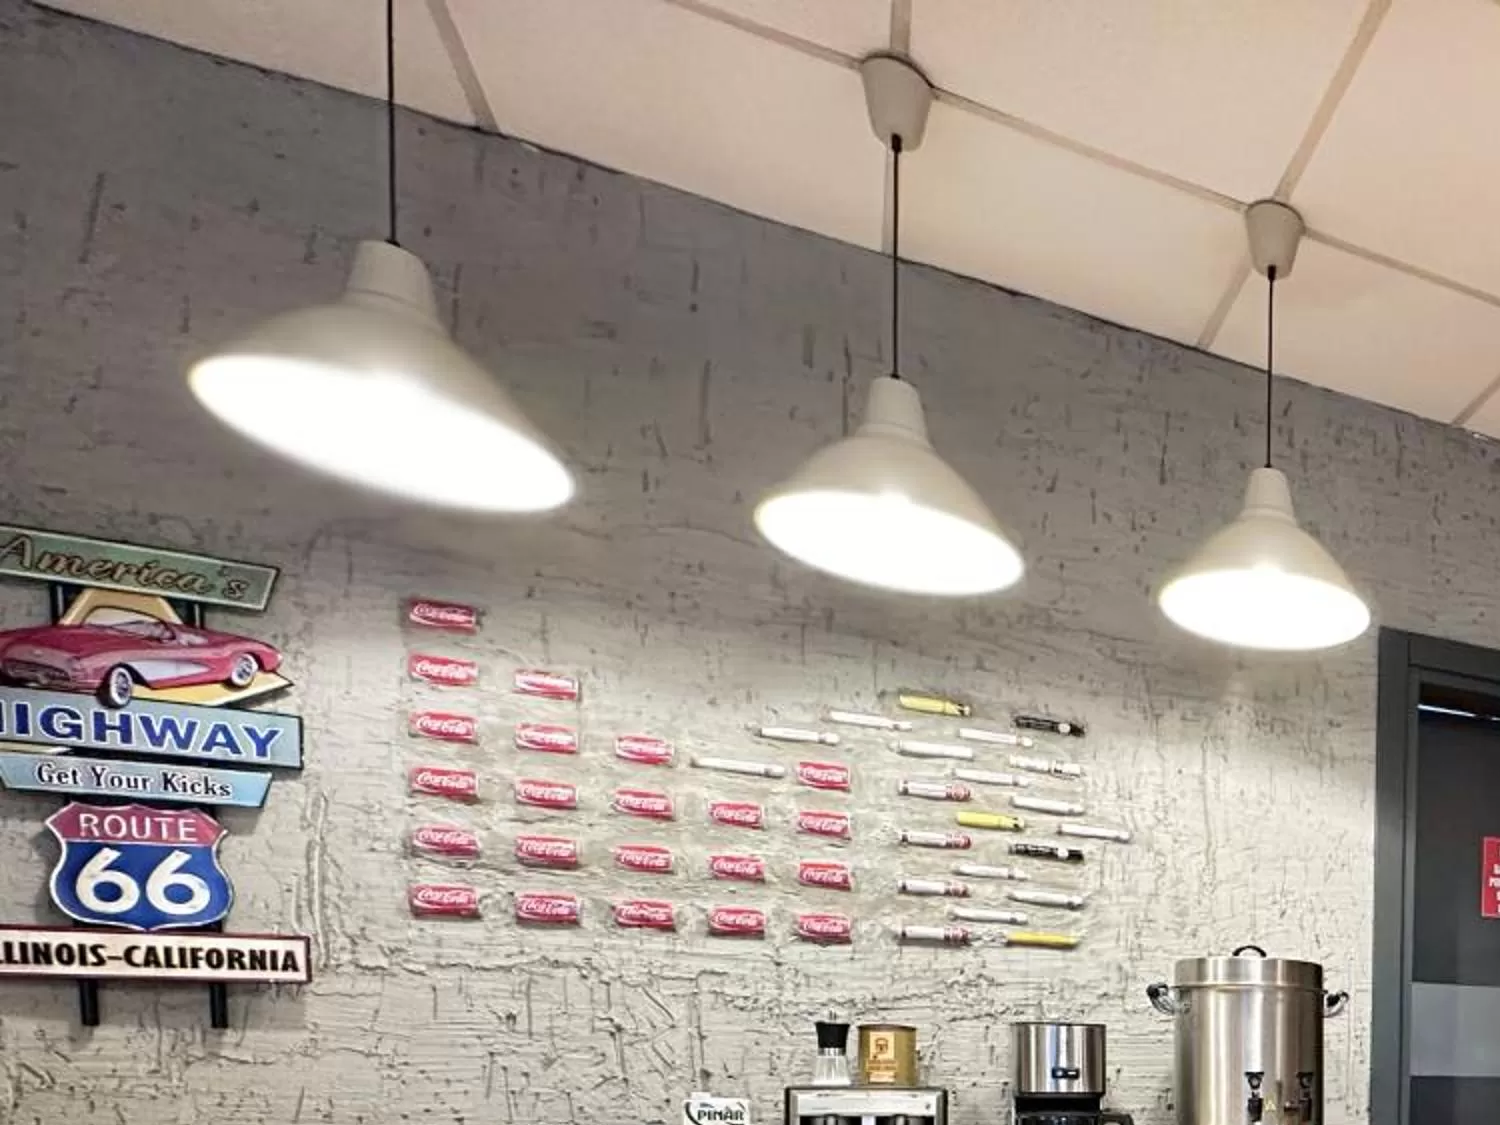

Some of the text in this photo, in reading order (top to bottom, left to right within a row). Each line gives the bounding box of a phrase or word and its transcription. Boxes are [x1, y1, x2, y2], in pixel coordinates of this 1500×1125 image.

[0, 534, 248, 598] America's
[0, 702, 280, 757] IGHWAY
[37, 762, 232, 797] Get Your Kicks
[79, 813, 198, 842] ROUTE
[75, 847, 211, 915] 66
[0, 941, 300, 972] LINOIS-CALIFORNIA
